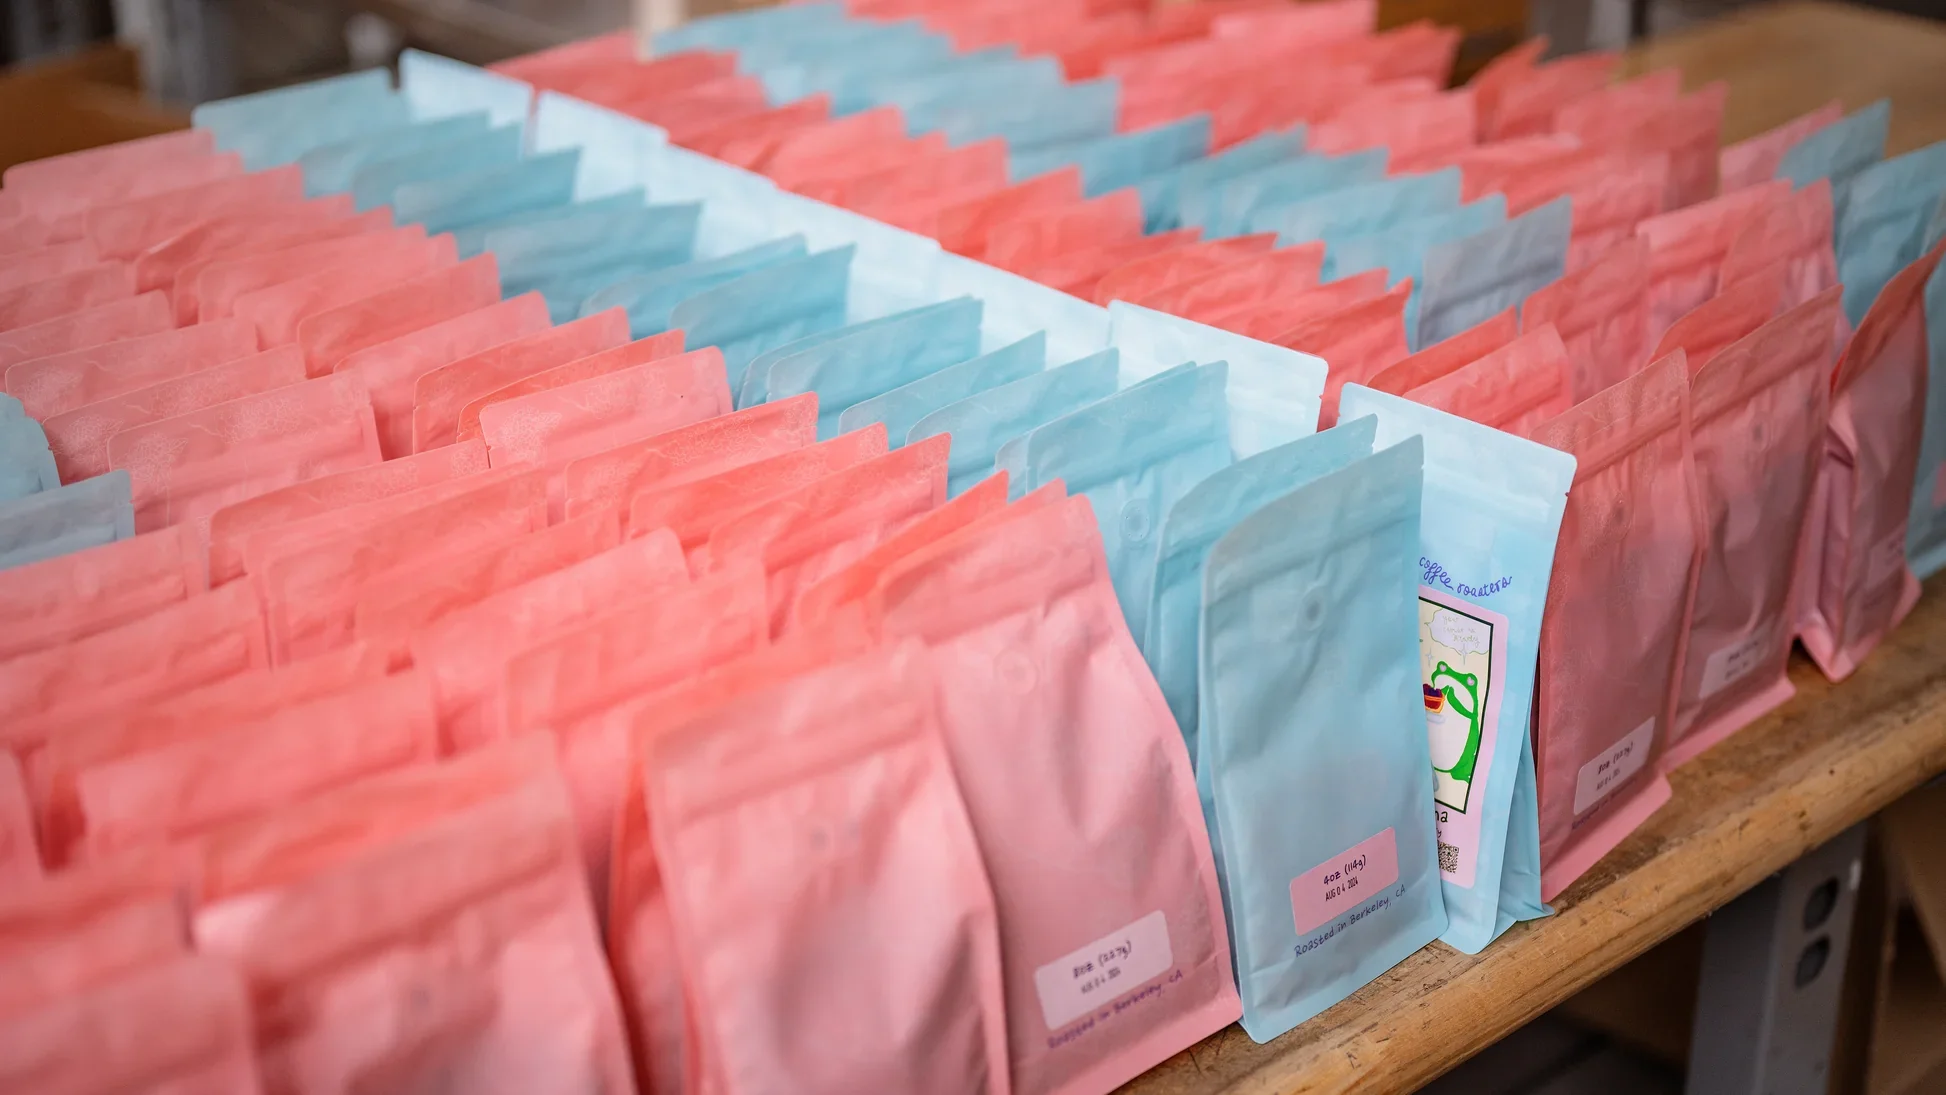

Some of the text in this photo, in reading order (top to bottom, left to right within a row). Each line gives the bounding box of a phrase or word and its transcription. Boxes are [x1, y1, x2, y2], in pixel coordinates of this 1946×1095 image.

[1419, 557, 1512, 597] coffee roasters
[1323, 854, 1366, 885] 4oz (114g)
[1325, 888, 1336, 901] AUG
[1347, 876, 1358, 889] 2024
[1294, 927, 1334, 957] Roasted
[1338, 921, 1347, 932] in
[1350, 897, 1391, 925] Berkeley,
